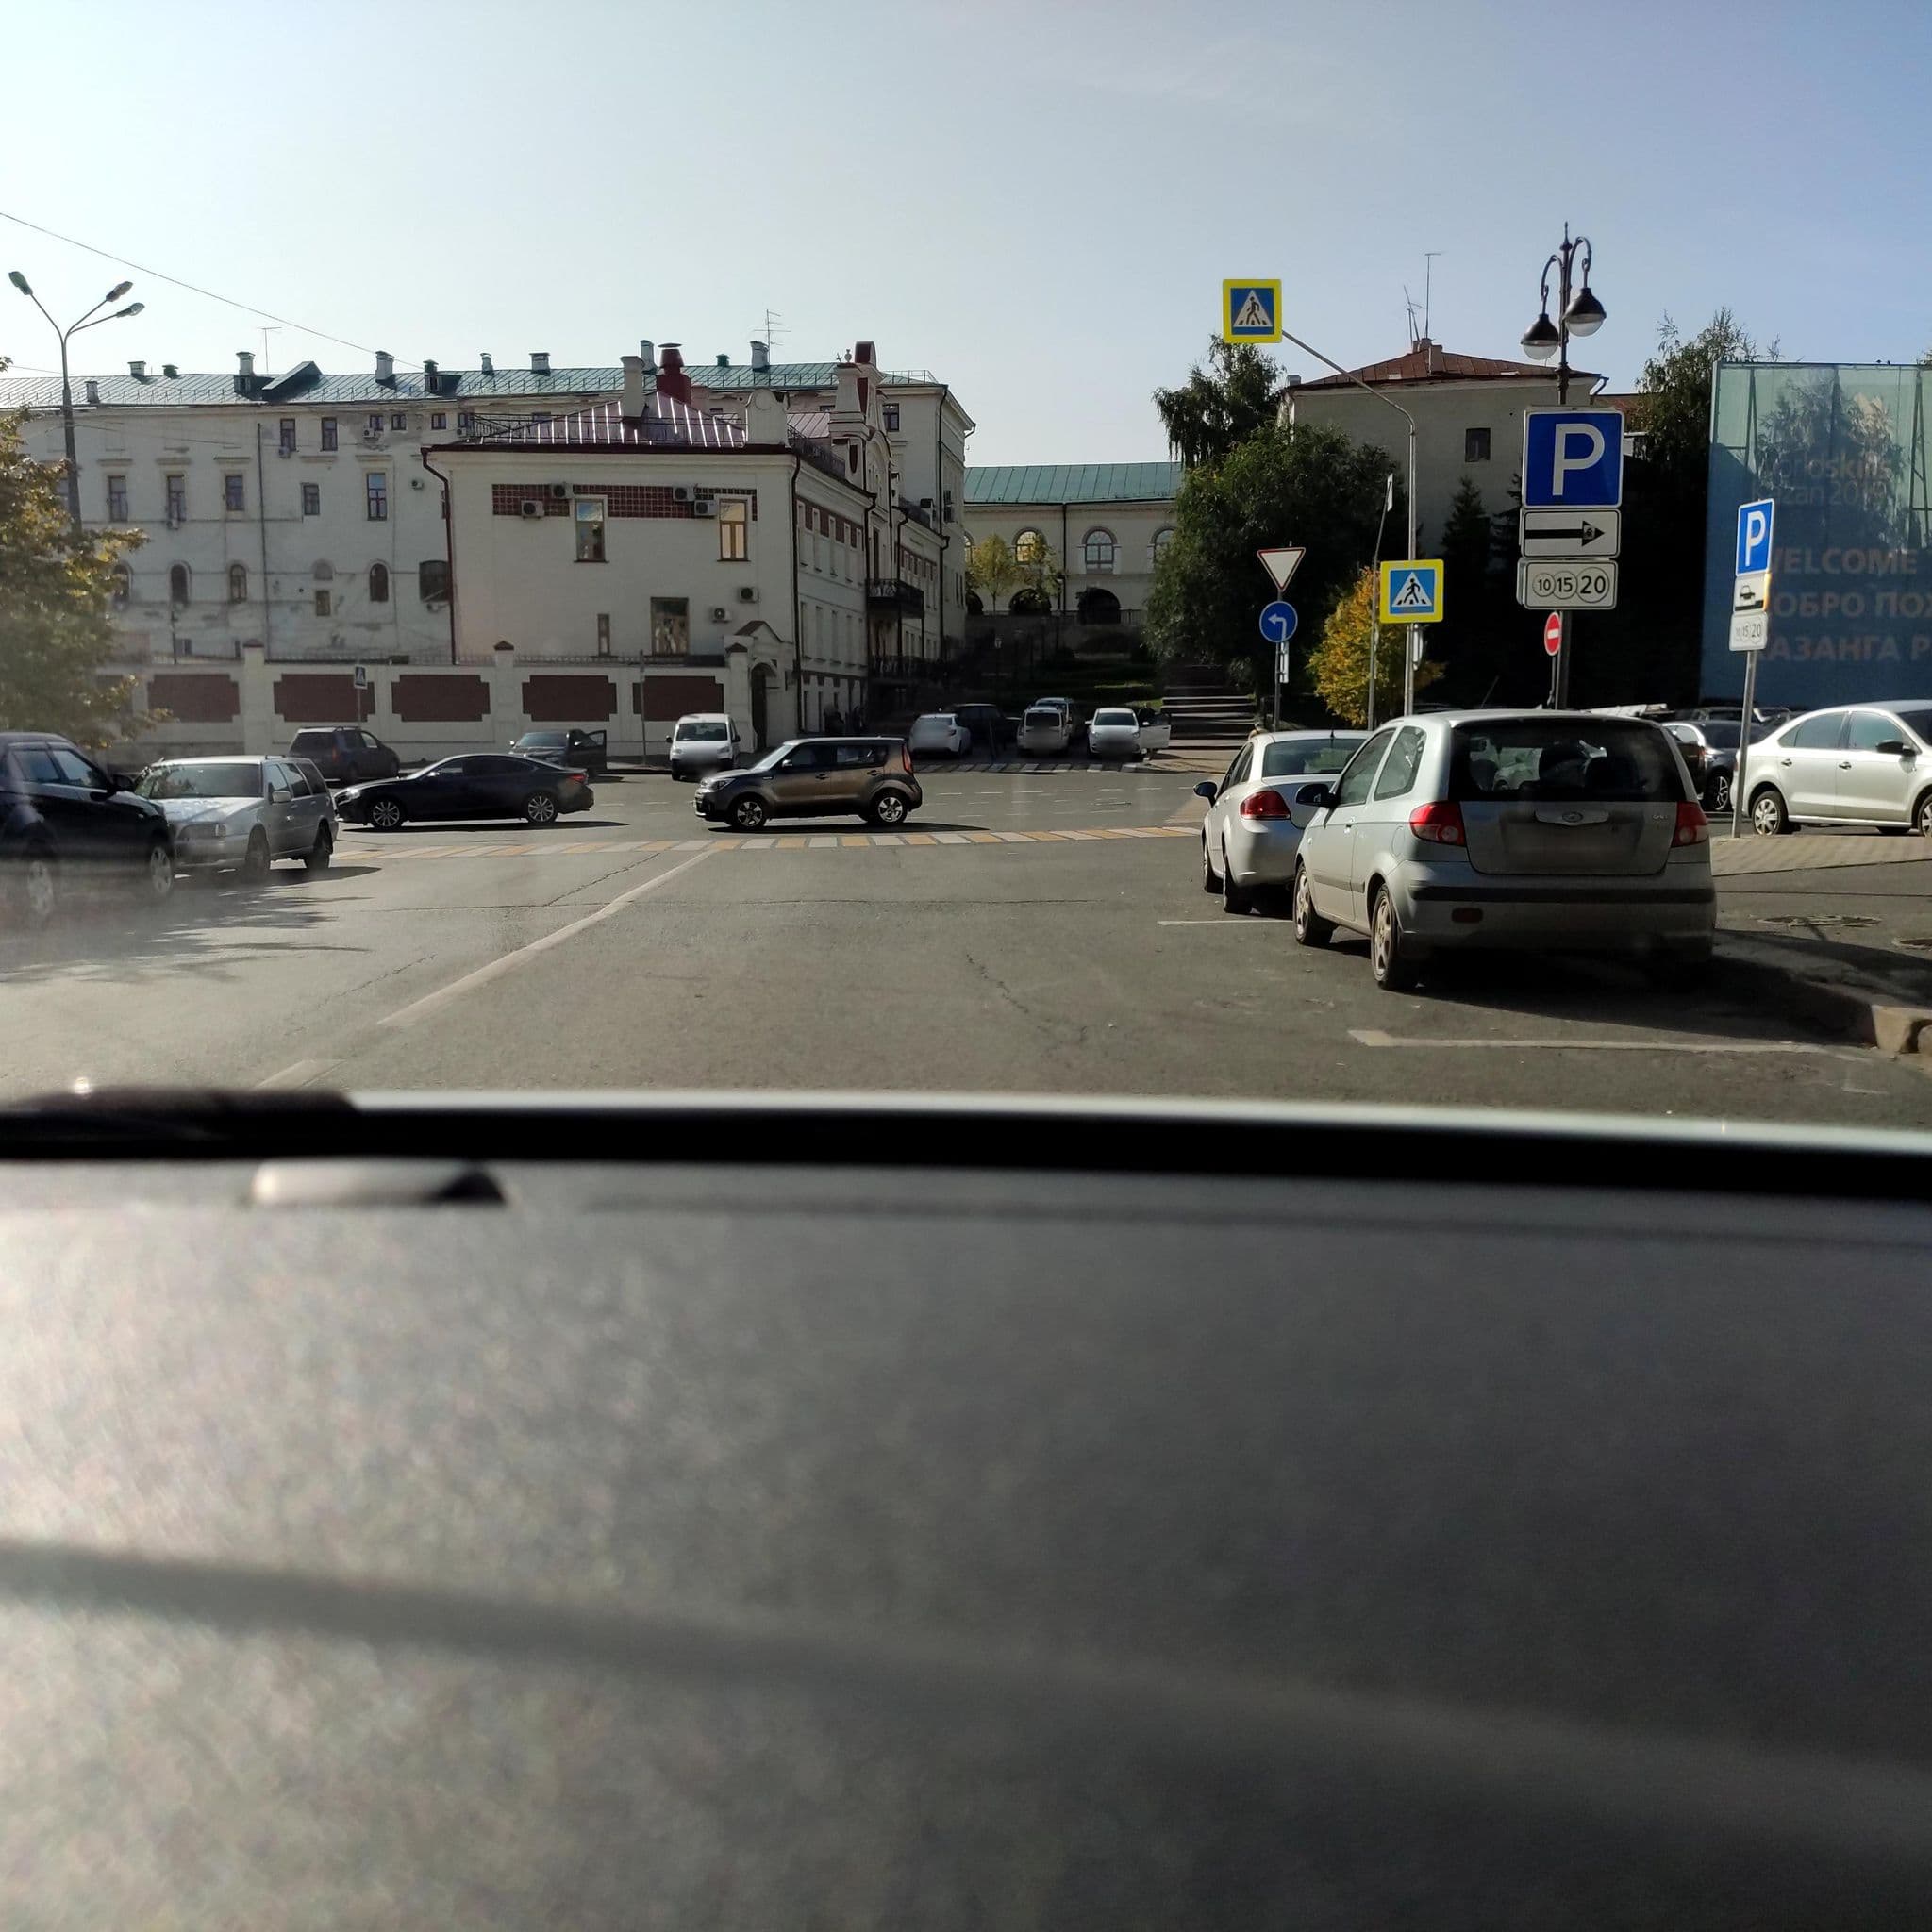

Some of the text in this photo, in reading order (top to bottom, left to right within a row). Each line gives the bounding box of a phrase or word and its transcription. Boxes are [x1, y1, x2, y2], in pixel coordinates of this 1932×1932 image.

[1552, 423, 1605, 496] P
[1745, 510, 1766, 567] P
[1538, 575, 1606, 594] 10 15 20
[1772, 591, 1866, 619] ОБРО
[1751, 623, 1761, 638] 20
[1761, 635, 1902, 662] АЗАНГА
